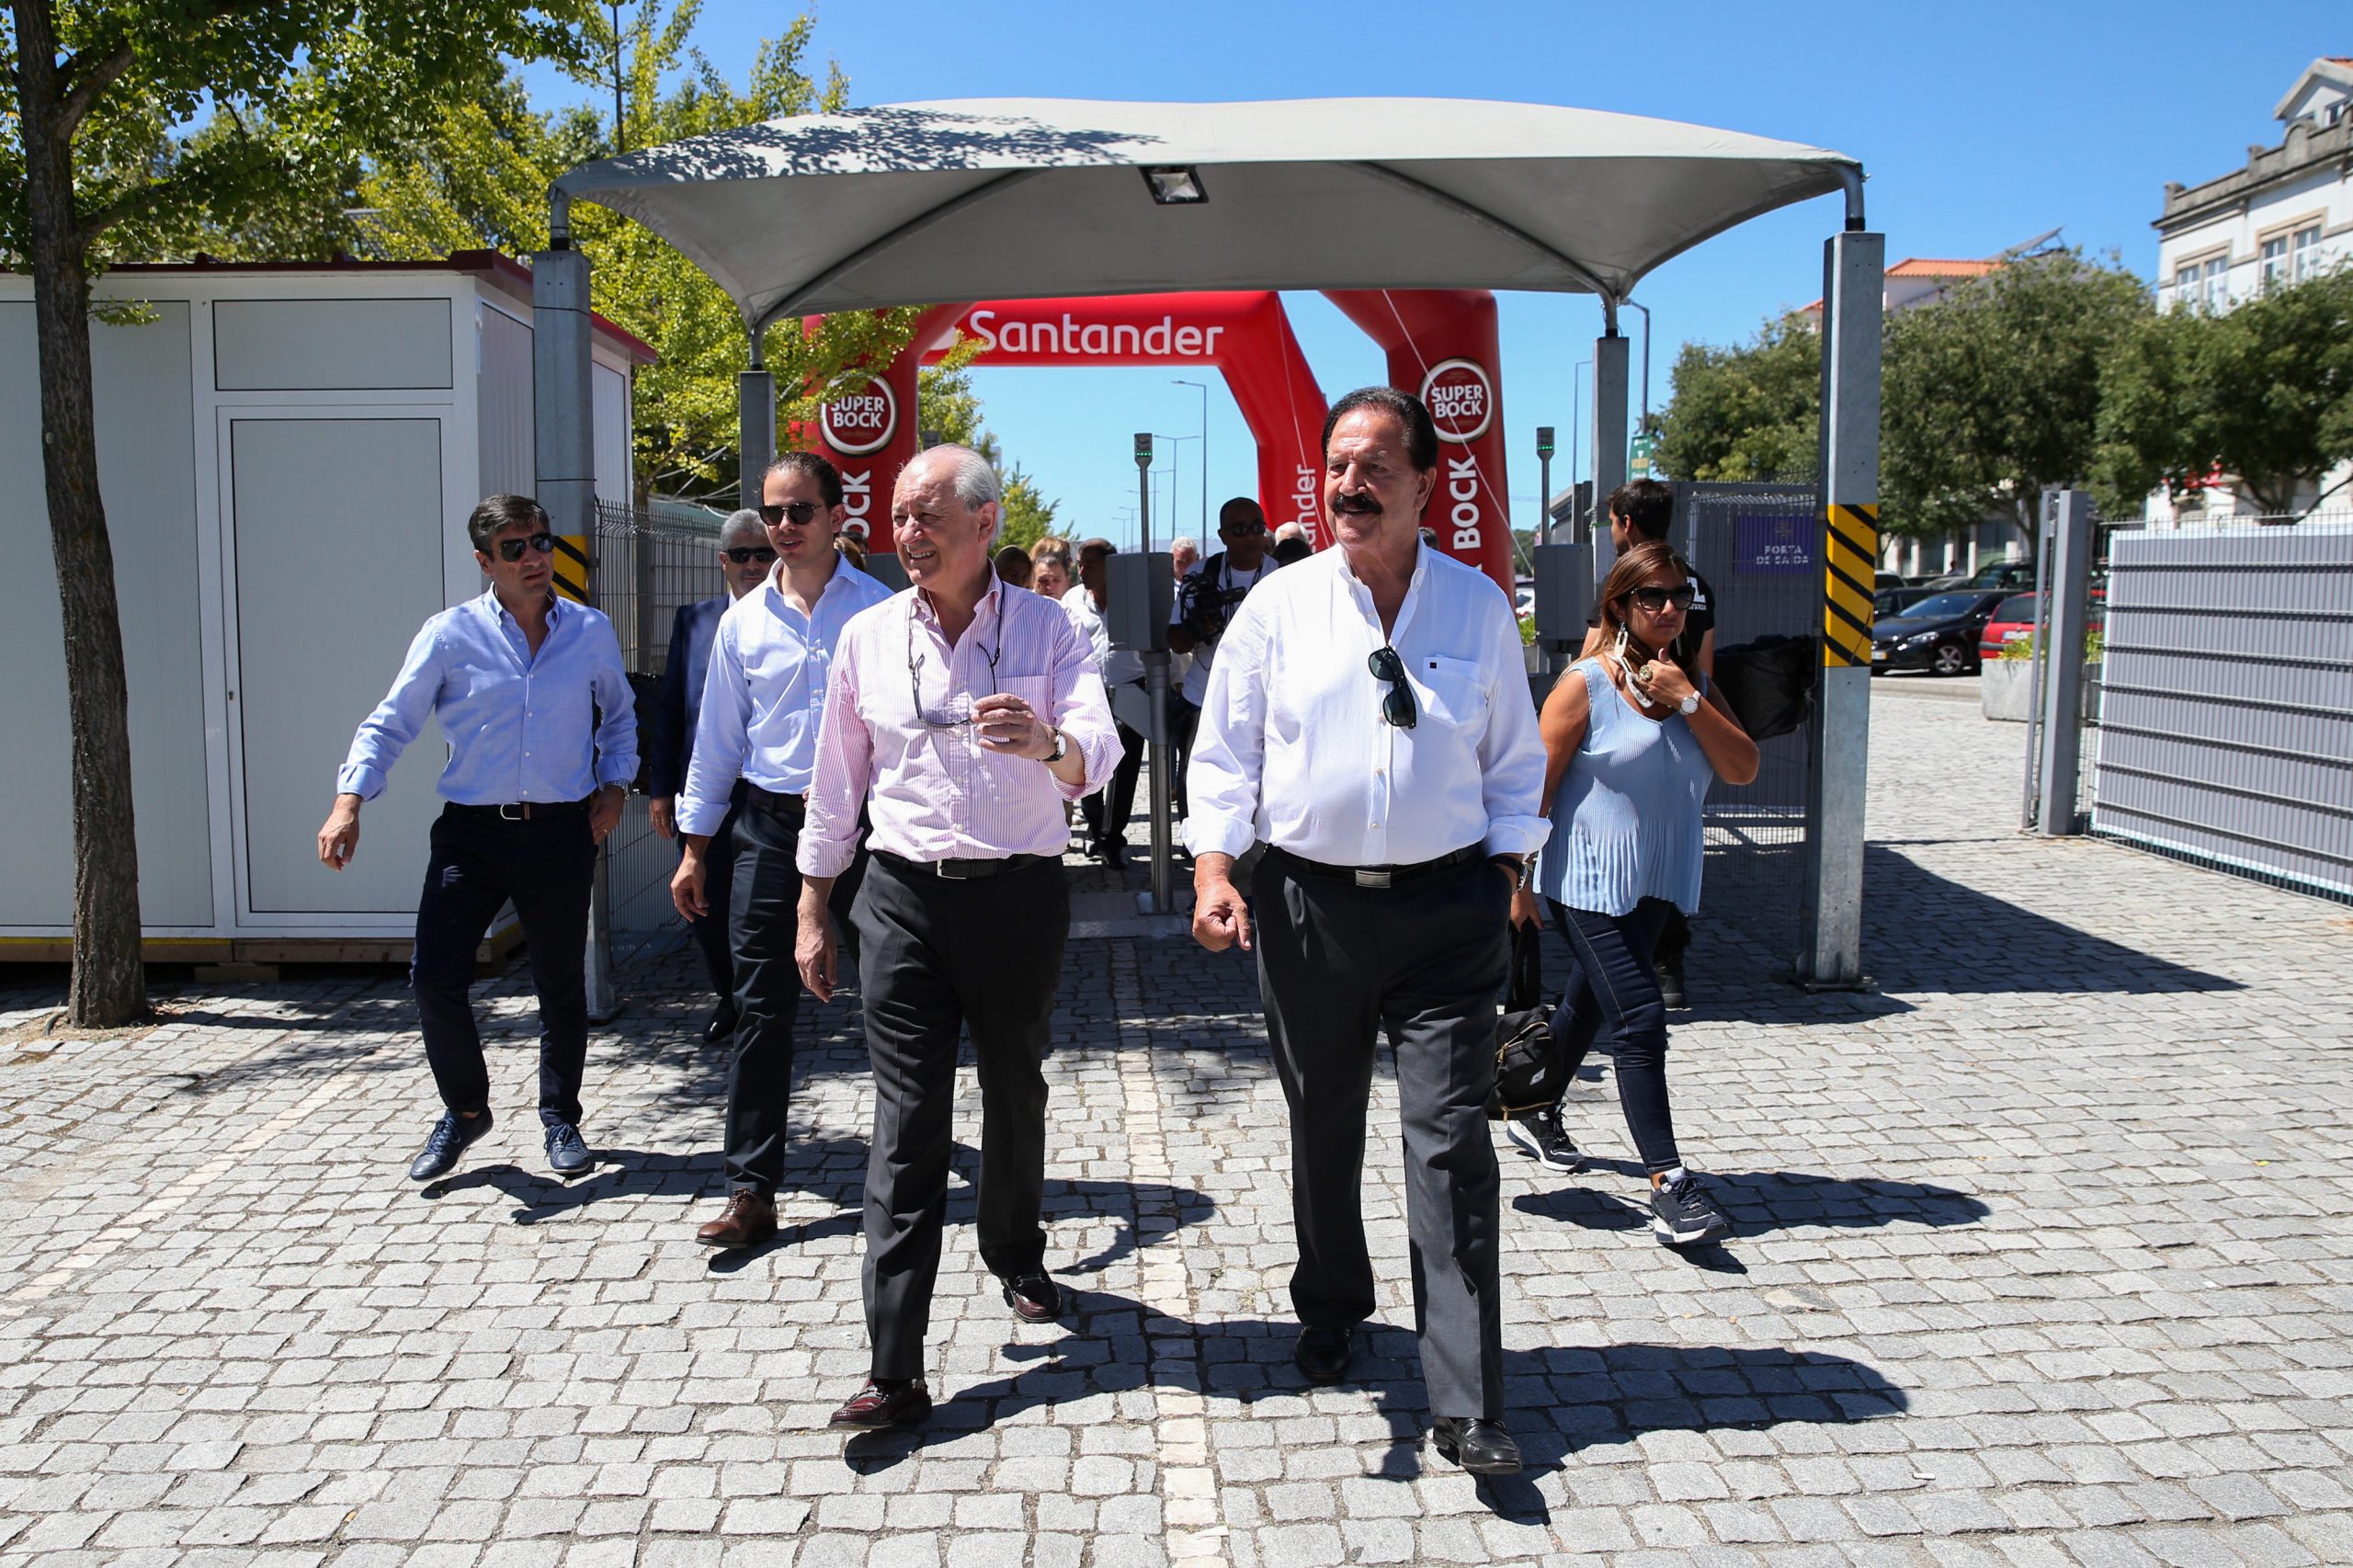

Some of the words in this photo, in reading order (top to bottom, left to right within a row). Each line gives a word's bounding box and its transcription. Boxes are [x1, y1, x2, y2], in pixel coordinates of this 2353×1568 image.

[970, 310, 1223, 356] Santander
[1431, 384, 1483, 403] SUPER
[1435, 401, 1483, 418] BOCK
[833, 412, 882, 428] BOCK
[841, 470, 871, 540] OCK
[1448, 454, 1482, 550] BOCK
[1775, 555, 1809, 564] SADA
